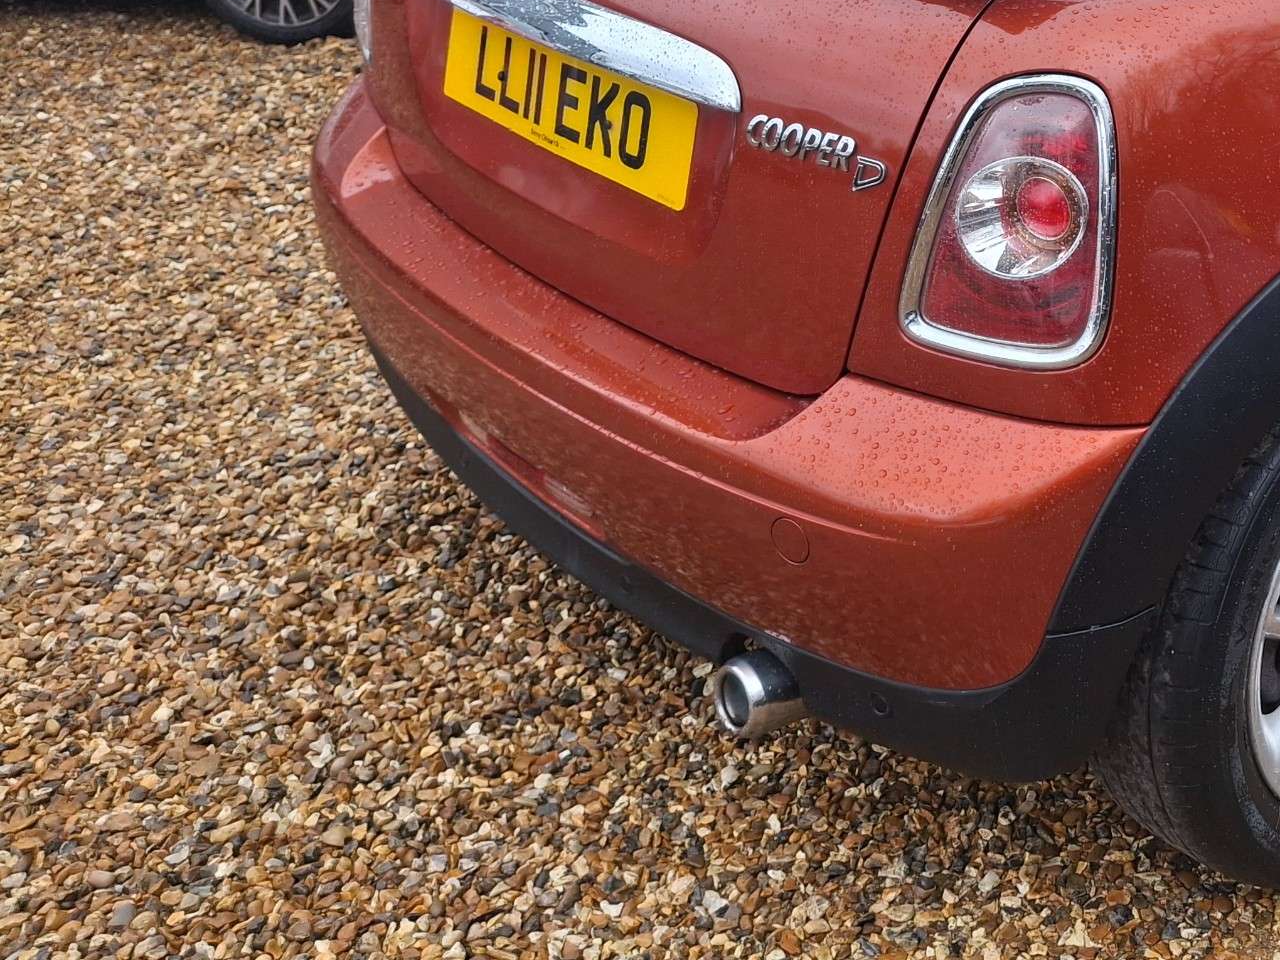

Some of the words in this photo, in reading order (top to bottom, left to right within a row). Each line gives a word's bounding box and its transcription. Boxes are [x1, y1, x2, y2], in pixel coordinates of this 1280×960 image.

[475, 25, 547, 126] LL11
[554, 62, 652, 170] EKO
[746, 113, 856, 172] COOPER
[852, 155, 887, 192] D
